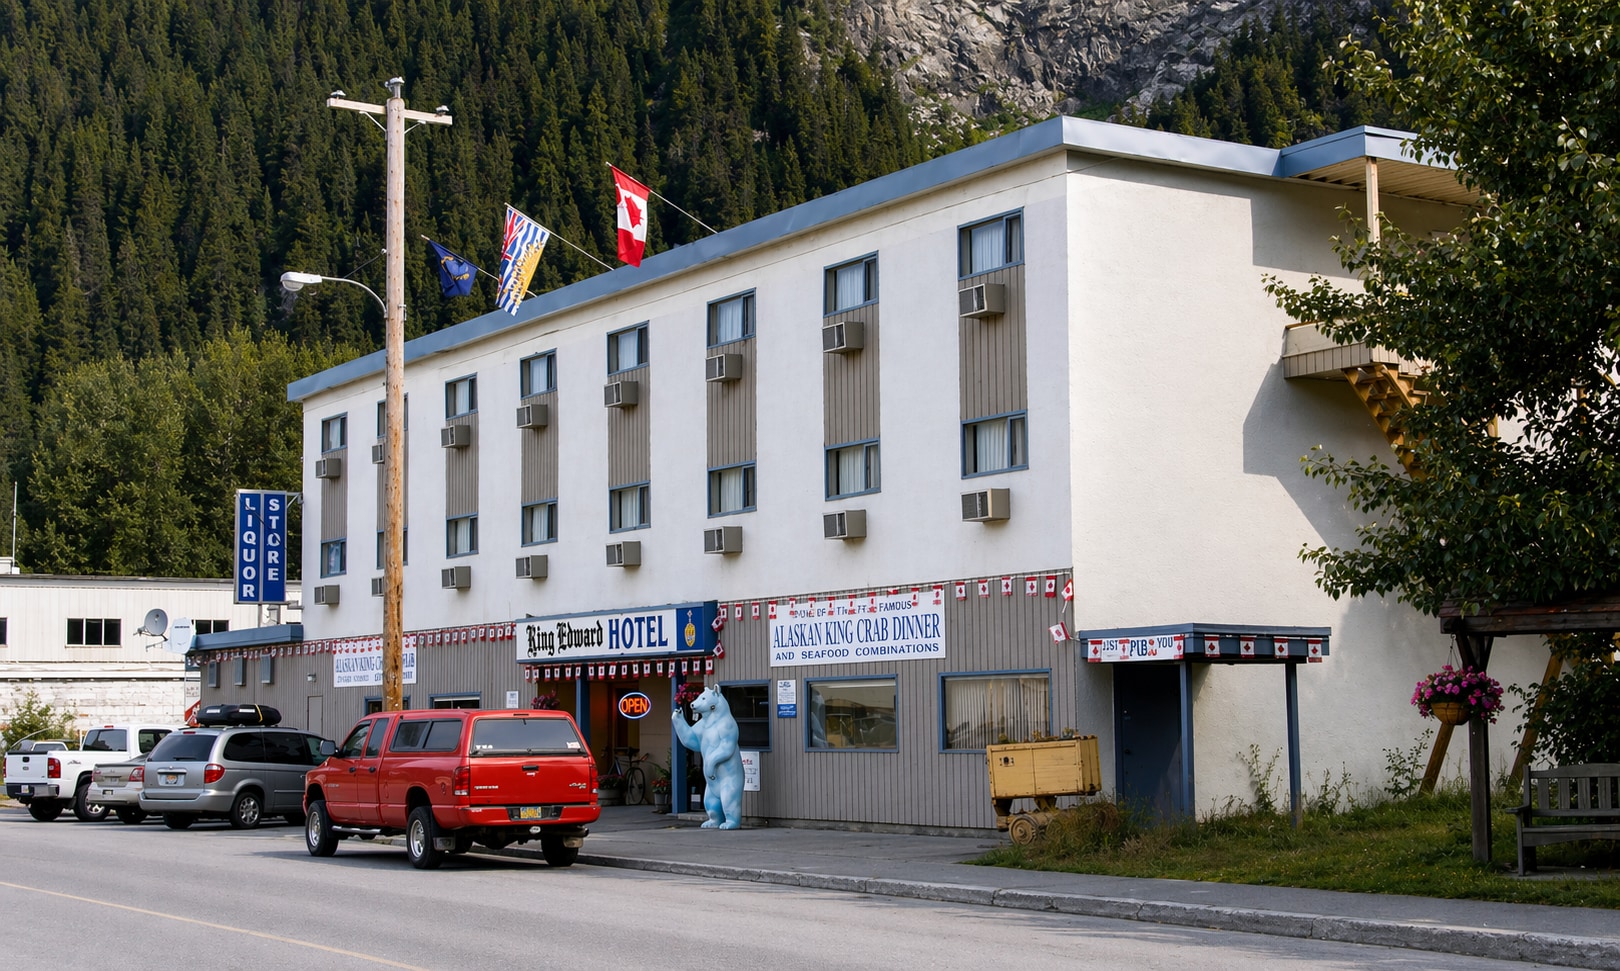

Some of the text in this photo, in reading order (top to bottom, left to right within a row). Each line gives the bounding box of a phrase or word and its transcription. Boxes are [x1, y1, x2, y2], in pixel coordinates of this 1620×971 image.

[242, 497, 257, 598] LIQUOR
[267, 498, 281, 581] STORE
[879, 600, 912, 613] FAMOUS
[525, 615, 668, 658] King Edward HOTEL
[773, 613, 941, 648] ALASKAN KING CRAB DINNER
[1157, 637, 1174, 648] YOU
[775, 642, 939, 661] AND SEAFOOD COMBINATIONS
[621, 697, 649, 714] OPEN
